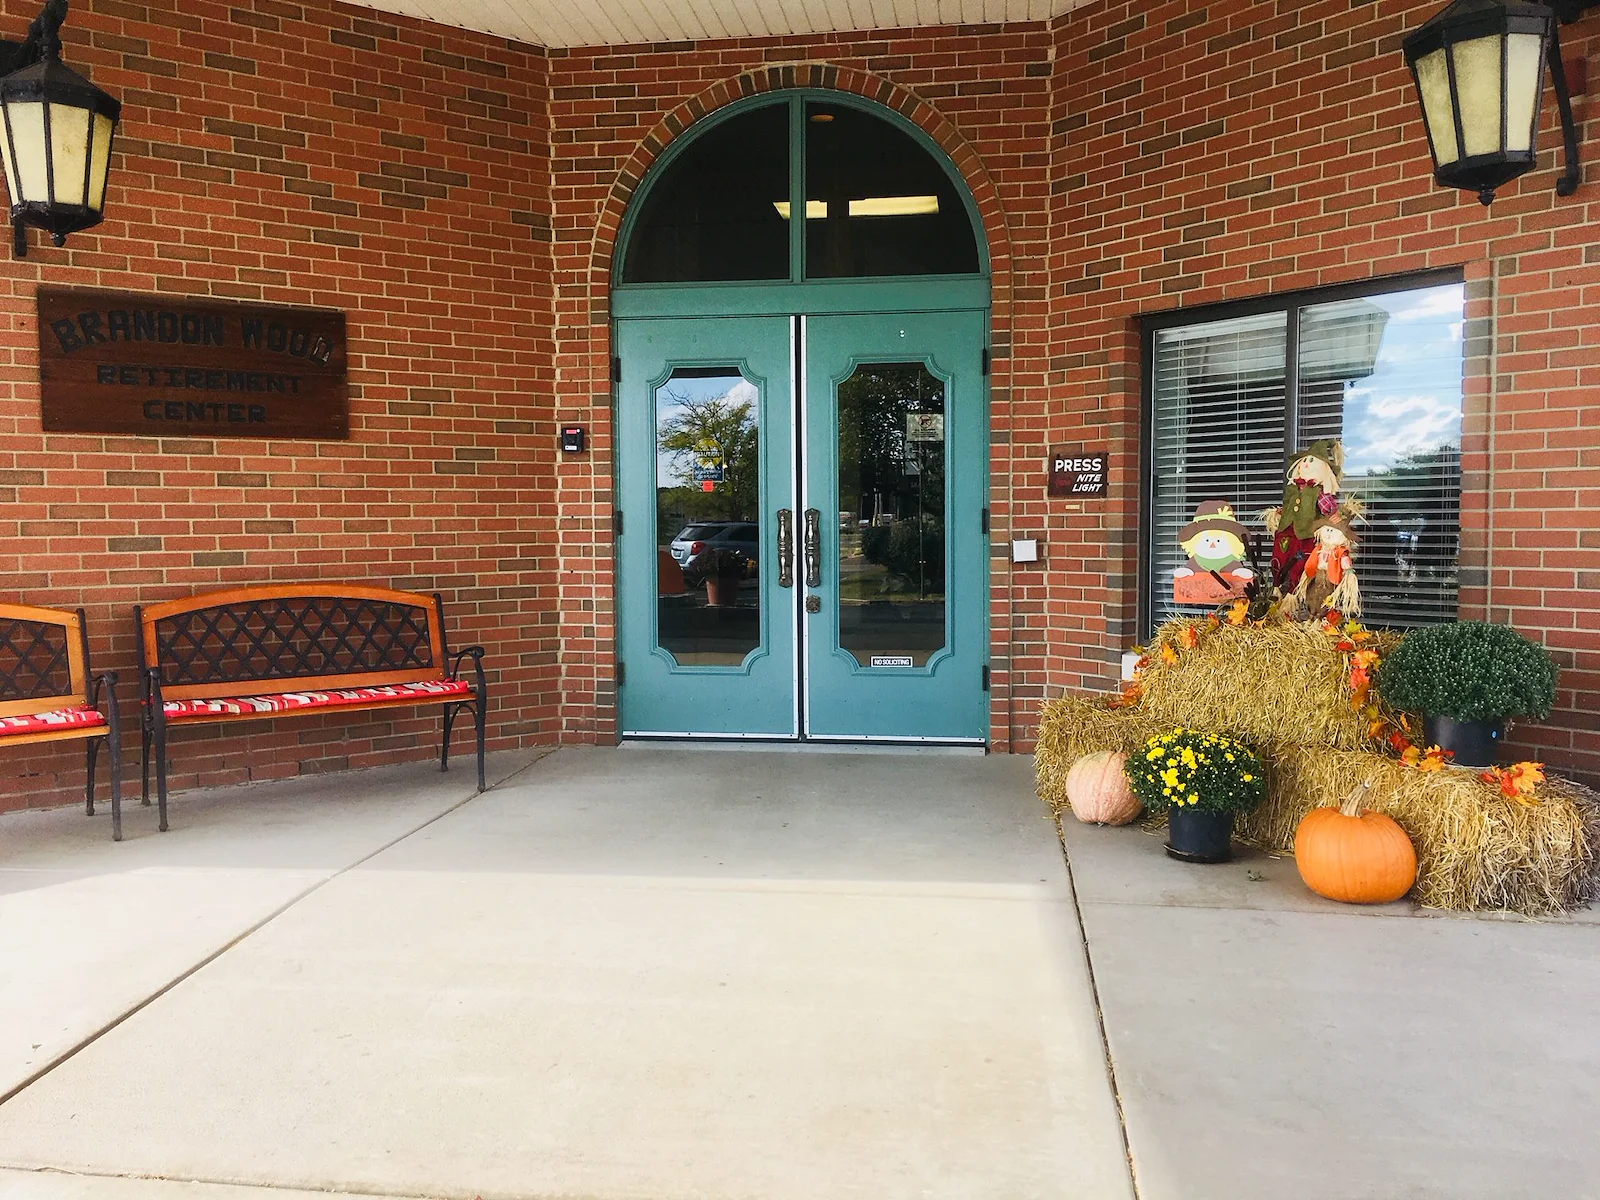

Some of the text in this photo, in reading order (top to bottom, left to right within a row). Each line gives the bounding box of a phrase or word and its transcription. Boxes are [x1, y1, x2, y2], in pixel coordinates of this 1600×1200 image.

[51, 309, 334, 367] BRANDON WOOD
[97, 364, 301, 393] RETIREMENT
[143, 400, 266, 423] CENTER
[1055, 458, 1102, 472] PRESS
[1076, 474, 1102, 482] NITE
[1072, 484, 1103, 492] LIGHT
